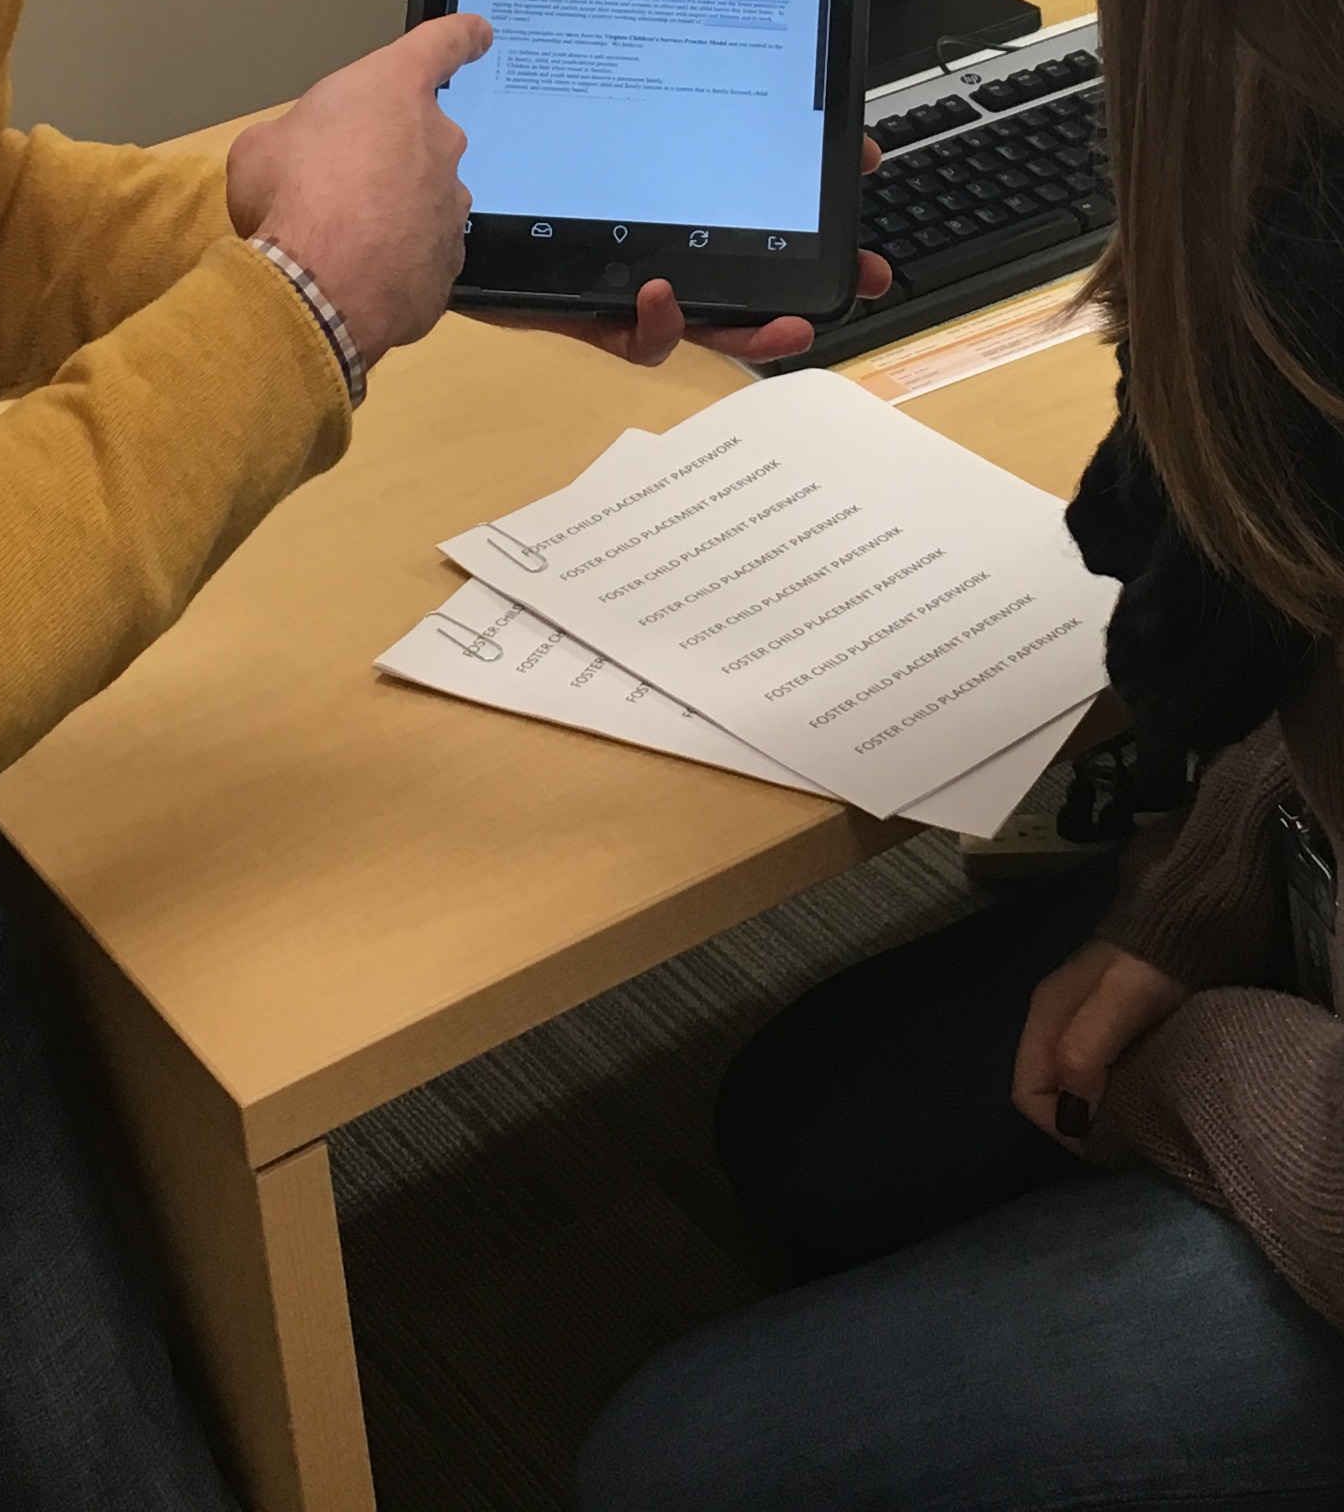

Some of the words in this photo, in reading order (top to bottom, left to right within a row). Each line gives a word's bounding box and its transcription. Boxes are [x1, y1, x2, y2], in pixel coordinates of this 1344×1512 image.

[521, 533, 567, 557] FOSTER
[567, 515, 602, 535] CHILD
[602, 477, 670, 516] PLACEMENT
[670, 437, 741, 480] PAPERWORK
[560, 557, 606, 580] FOSTER
[605, 537, 641, 558] CHILD
[641, 500, 709, 539] PLACEMENT
[709, 459, 781, 501] PAPERWORK
[598, 579, 644, 603] FOSTER
[644, 560, 680, 580] CHILD
[680, 522, 749, 561] PLACEMENT
[749, 483, 821, 523] PAPERWORK
[638, 601, 685, 626] FOSTER
[685, 583, 721, 602] CHILD
[720, 543, 789, 584] PLACEMENT
[789, 505, 862, 546] PAPERWORK
[679, 623, 727, 649] FOSTER
[726, 605, 762, 624] CHILD
[761, 566, 831, 606] PLACEMENT
[831, 527, 904, 568] PAPERWORK
[721, 648, 769, 674] FOSTER
[768, 628, 805, 649] CHILD
[804, 589, 874, 629] PLACEMENT
[873, 548, 946, 591] PAPERWORK
[516, 642, 554, 674] FOSTER
[764, 674, 813, 701] FOSTER
[811, 654, 848, 675] CHILD
[847, 612, 918, 655] PLACEMENT
[917, 571, 991, 614] PAPERWORK
[809, 700, 858, 728] FOSTER
[856, 679, 893, 701] CHILD
[892, 636, 963, 679] PLACEMENT
[962, 594, 1036, 638] PAPERWORK
[855, 725, 903, 754] FOSTER
[901, 703, 939, 726] CHILD
[937, 661, 1009, 704] PLACEMENT
[1008, 618, 1081, 662] PAPERWORK
